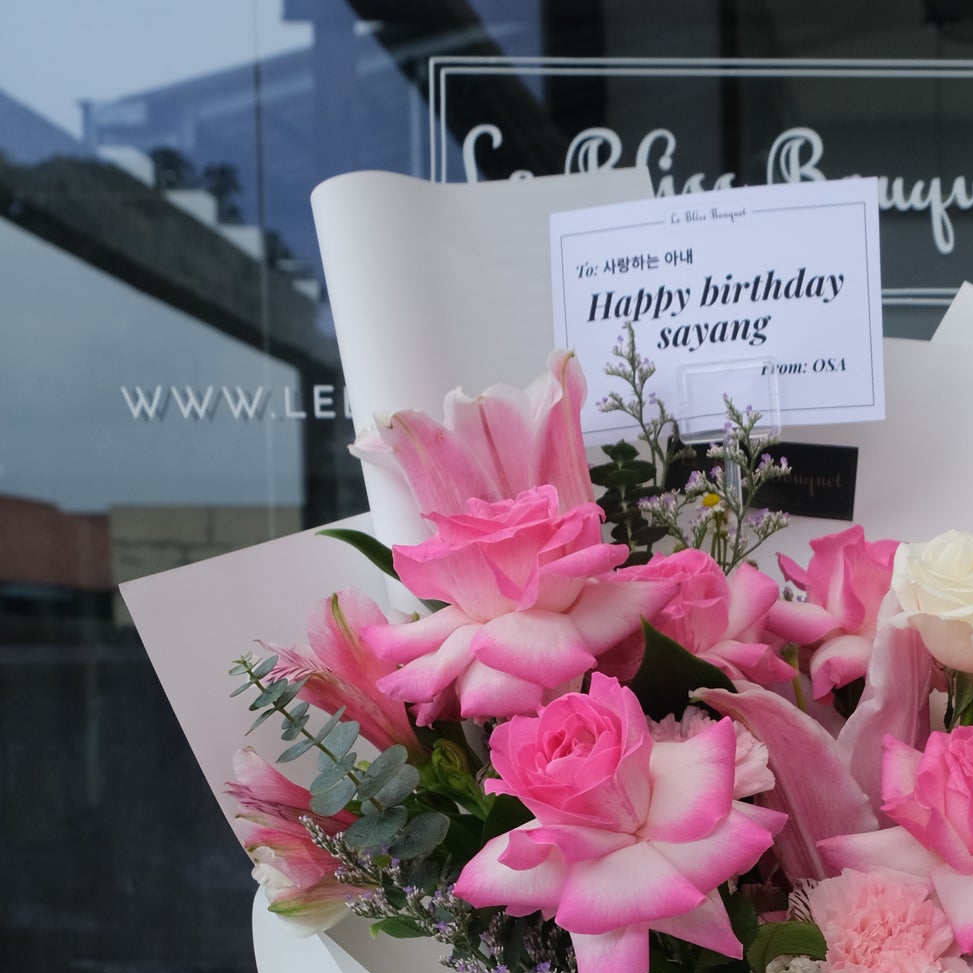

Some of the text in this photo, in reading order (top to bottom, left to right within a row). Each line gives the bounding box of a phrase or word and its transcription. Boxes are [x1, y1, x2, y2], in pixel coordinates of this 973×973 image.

[576, 248, 693, 279] To: 사랑하는 아내
[587, 267, 845, 323] Happy birthday
[657, 315, 772, 352] sayang
[813, 358, 846, 374] OSA
